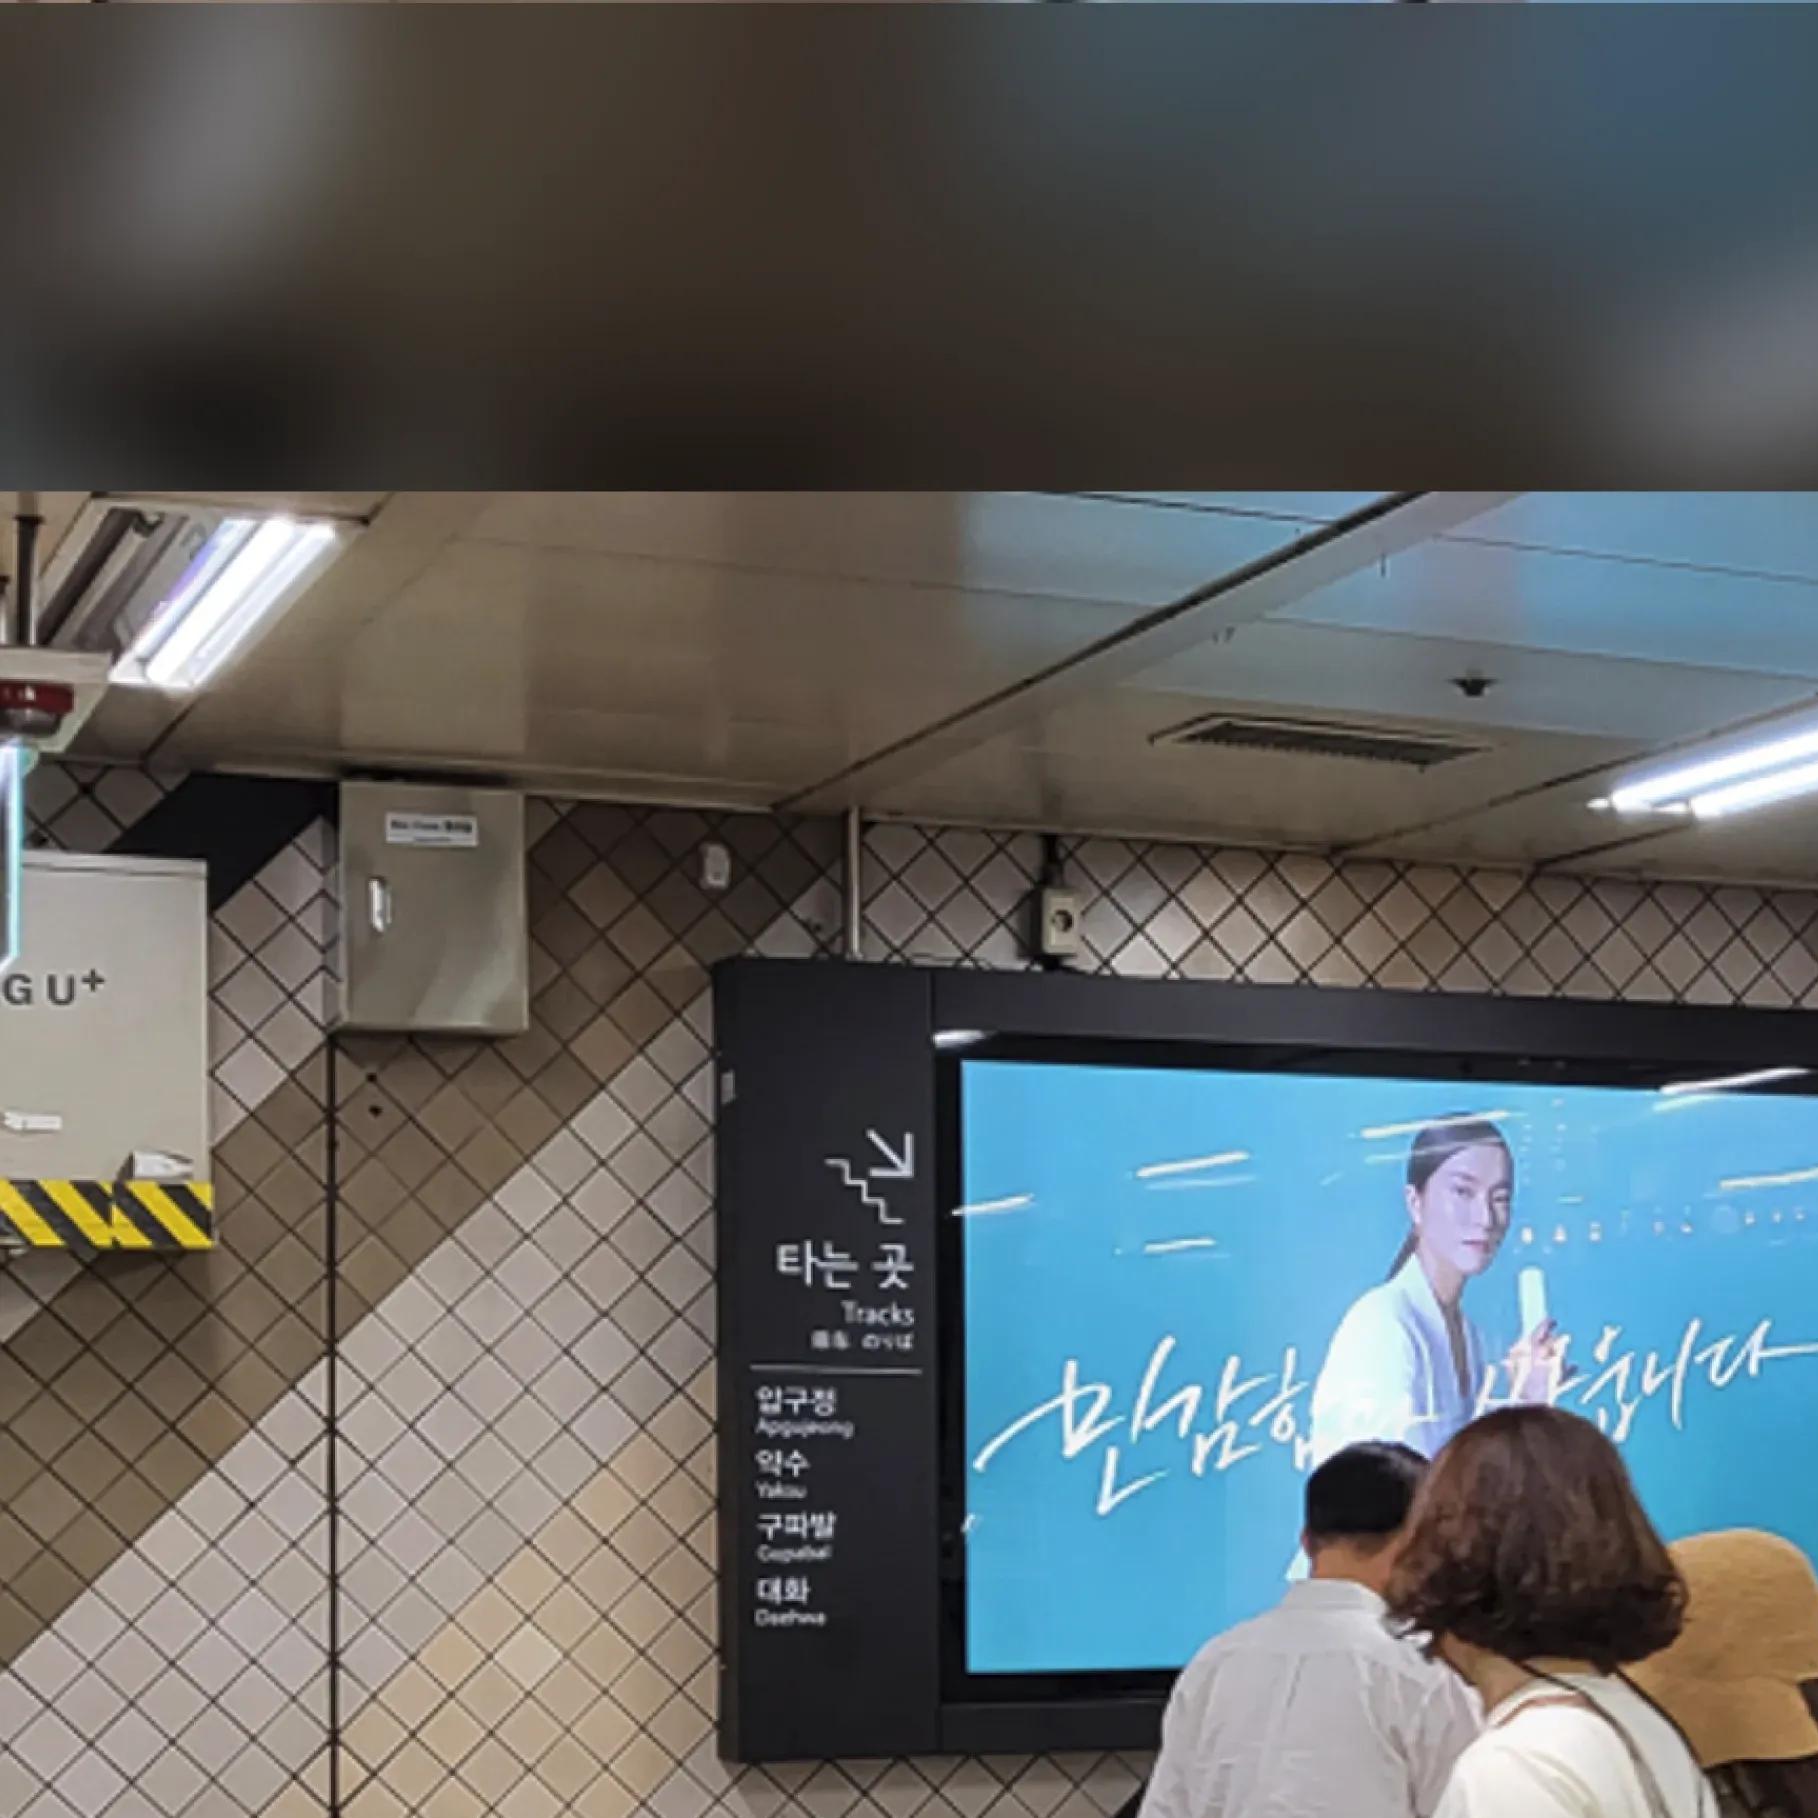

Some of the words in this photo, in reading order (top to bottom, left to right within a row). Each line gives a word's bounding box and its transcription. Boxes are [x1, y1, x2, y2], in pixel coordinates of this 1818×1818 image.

[775, 1239, 859, 1290] 타는
[871, 1242, 915, 1290] 곳
[840, 1299, 915, 1327] Tracks
[755, 1384, 837, 1417] 압구정
[754, 1448, 811, 1478] 약수
[756, 1510, 837, 1541] 구파발
[756, 1575, 811, 1605] 대화
